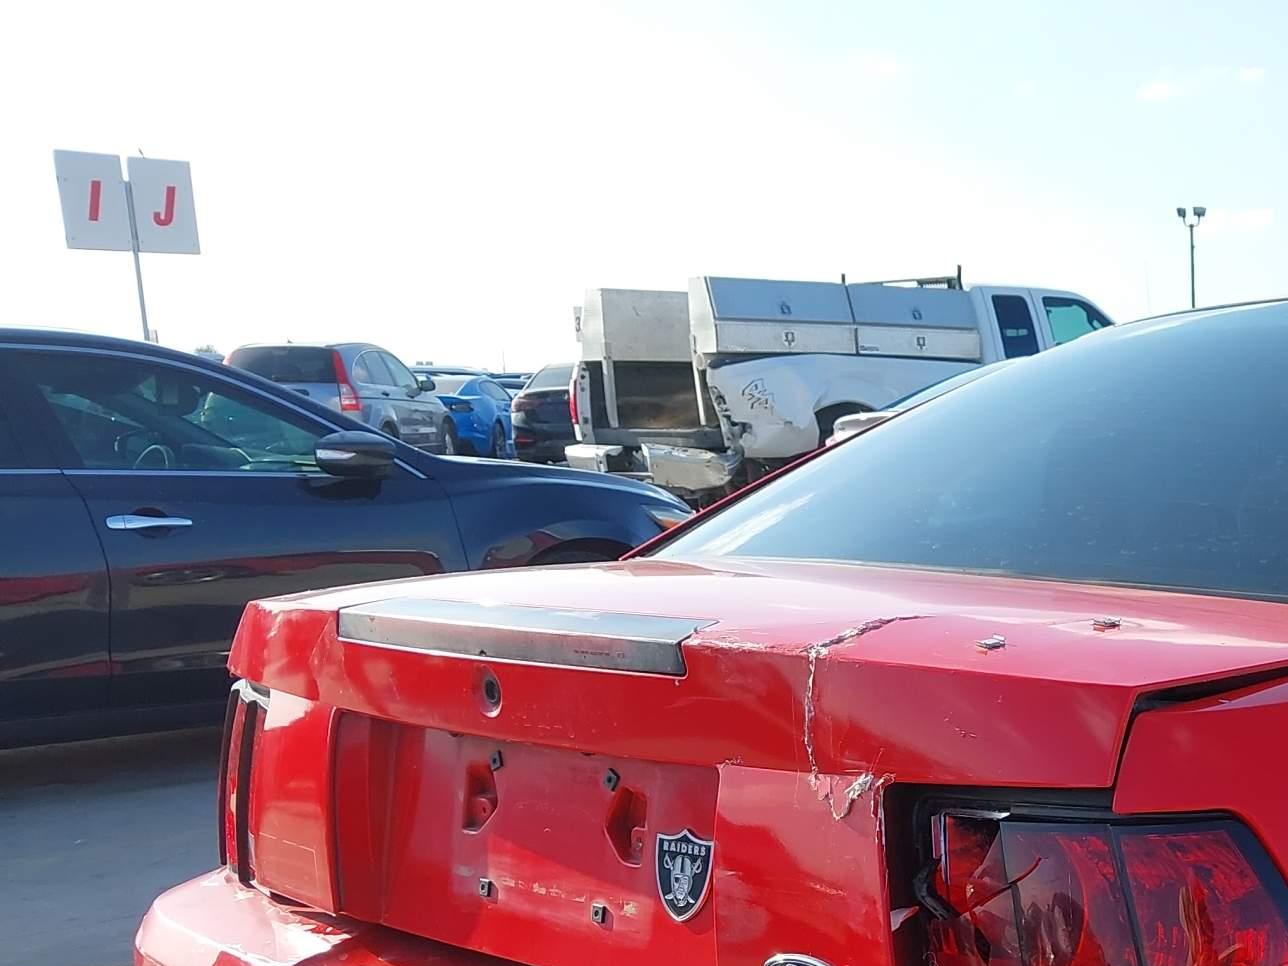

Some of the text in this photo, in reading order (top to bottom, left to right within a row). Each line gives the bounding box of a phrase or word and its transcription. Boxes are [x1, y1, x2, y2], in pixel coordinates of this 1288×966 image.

[88, 179, 101, 222] I
[153, 185, 176, 227] J
[662, 840, 706, 857] RAIDERS
